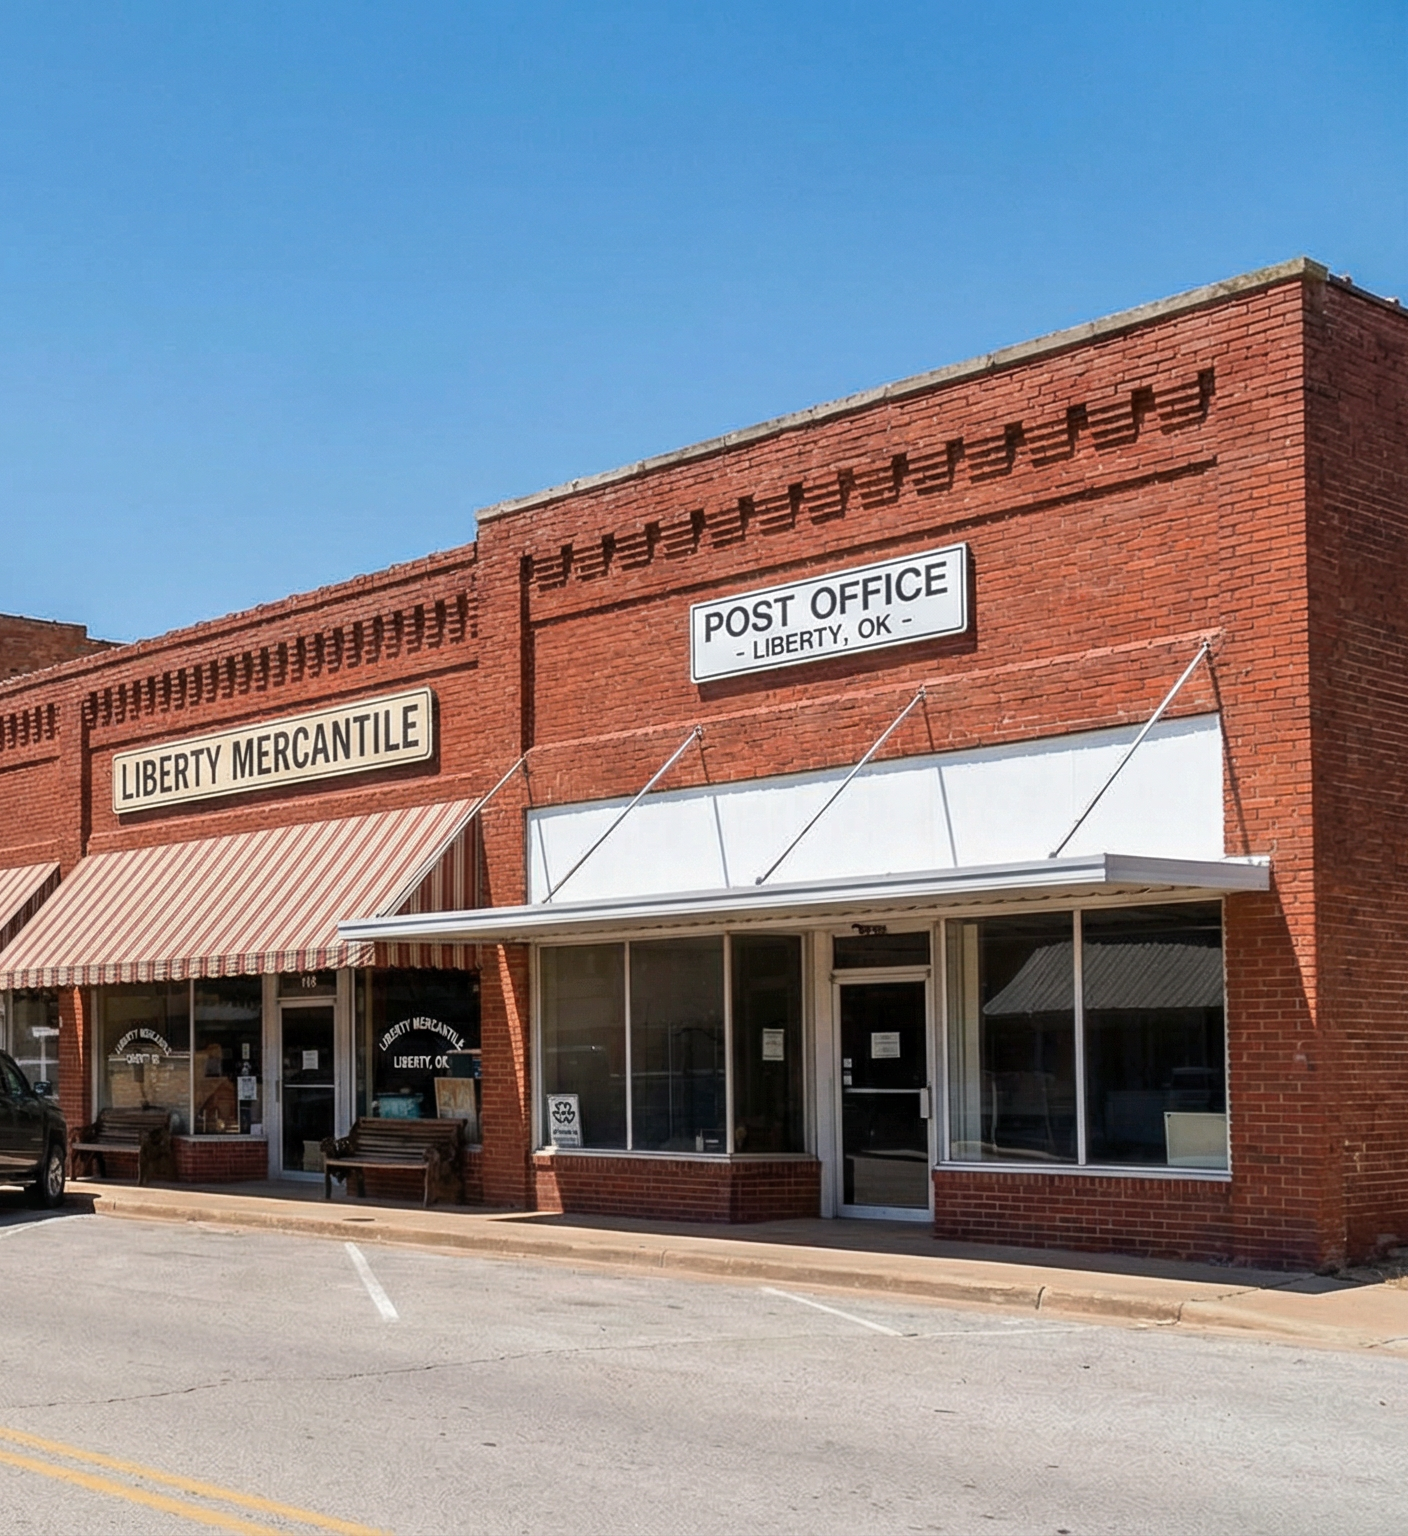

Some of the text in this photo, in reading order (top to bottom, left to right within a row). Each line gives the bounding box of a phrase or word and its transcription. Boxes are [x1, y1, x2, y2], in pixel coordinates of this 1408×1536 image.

[704, 561, 948, 643] POST OFFICE
[753, 624, 849, 660] LIBERTY,
[858, 614, 892, 639] OK
[121, 703, 420, 801] LIBERTY MERCANTILE
[434, 1055, 450, 1069] OK
